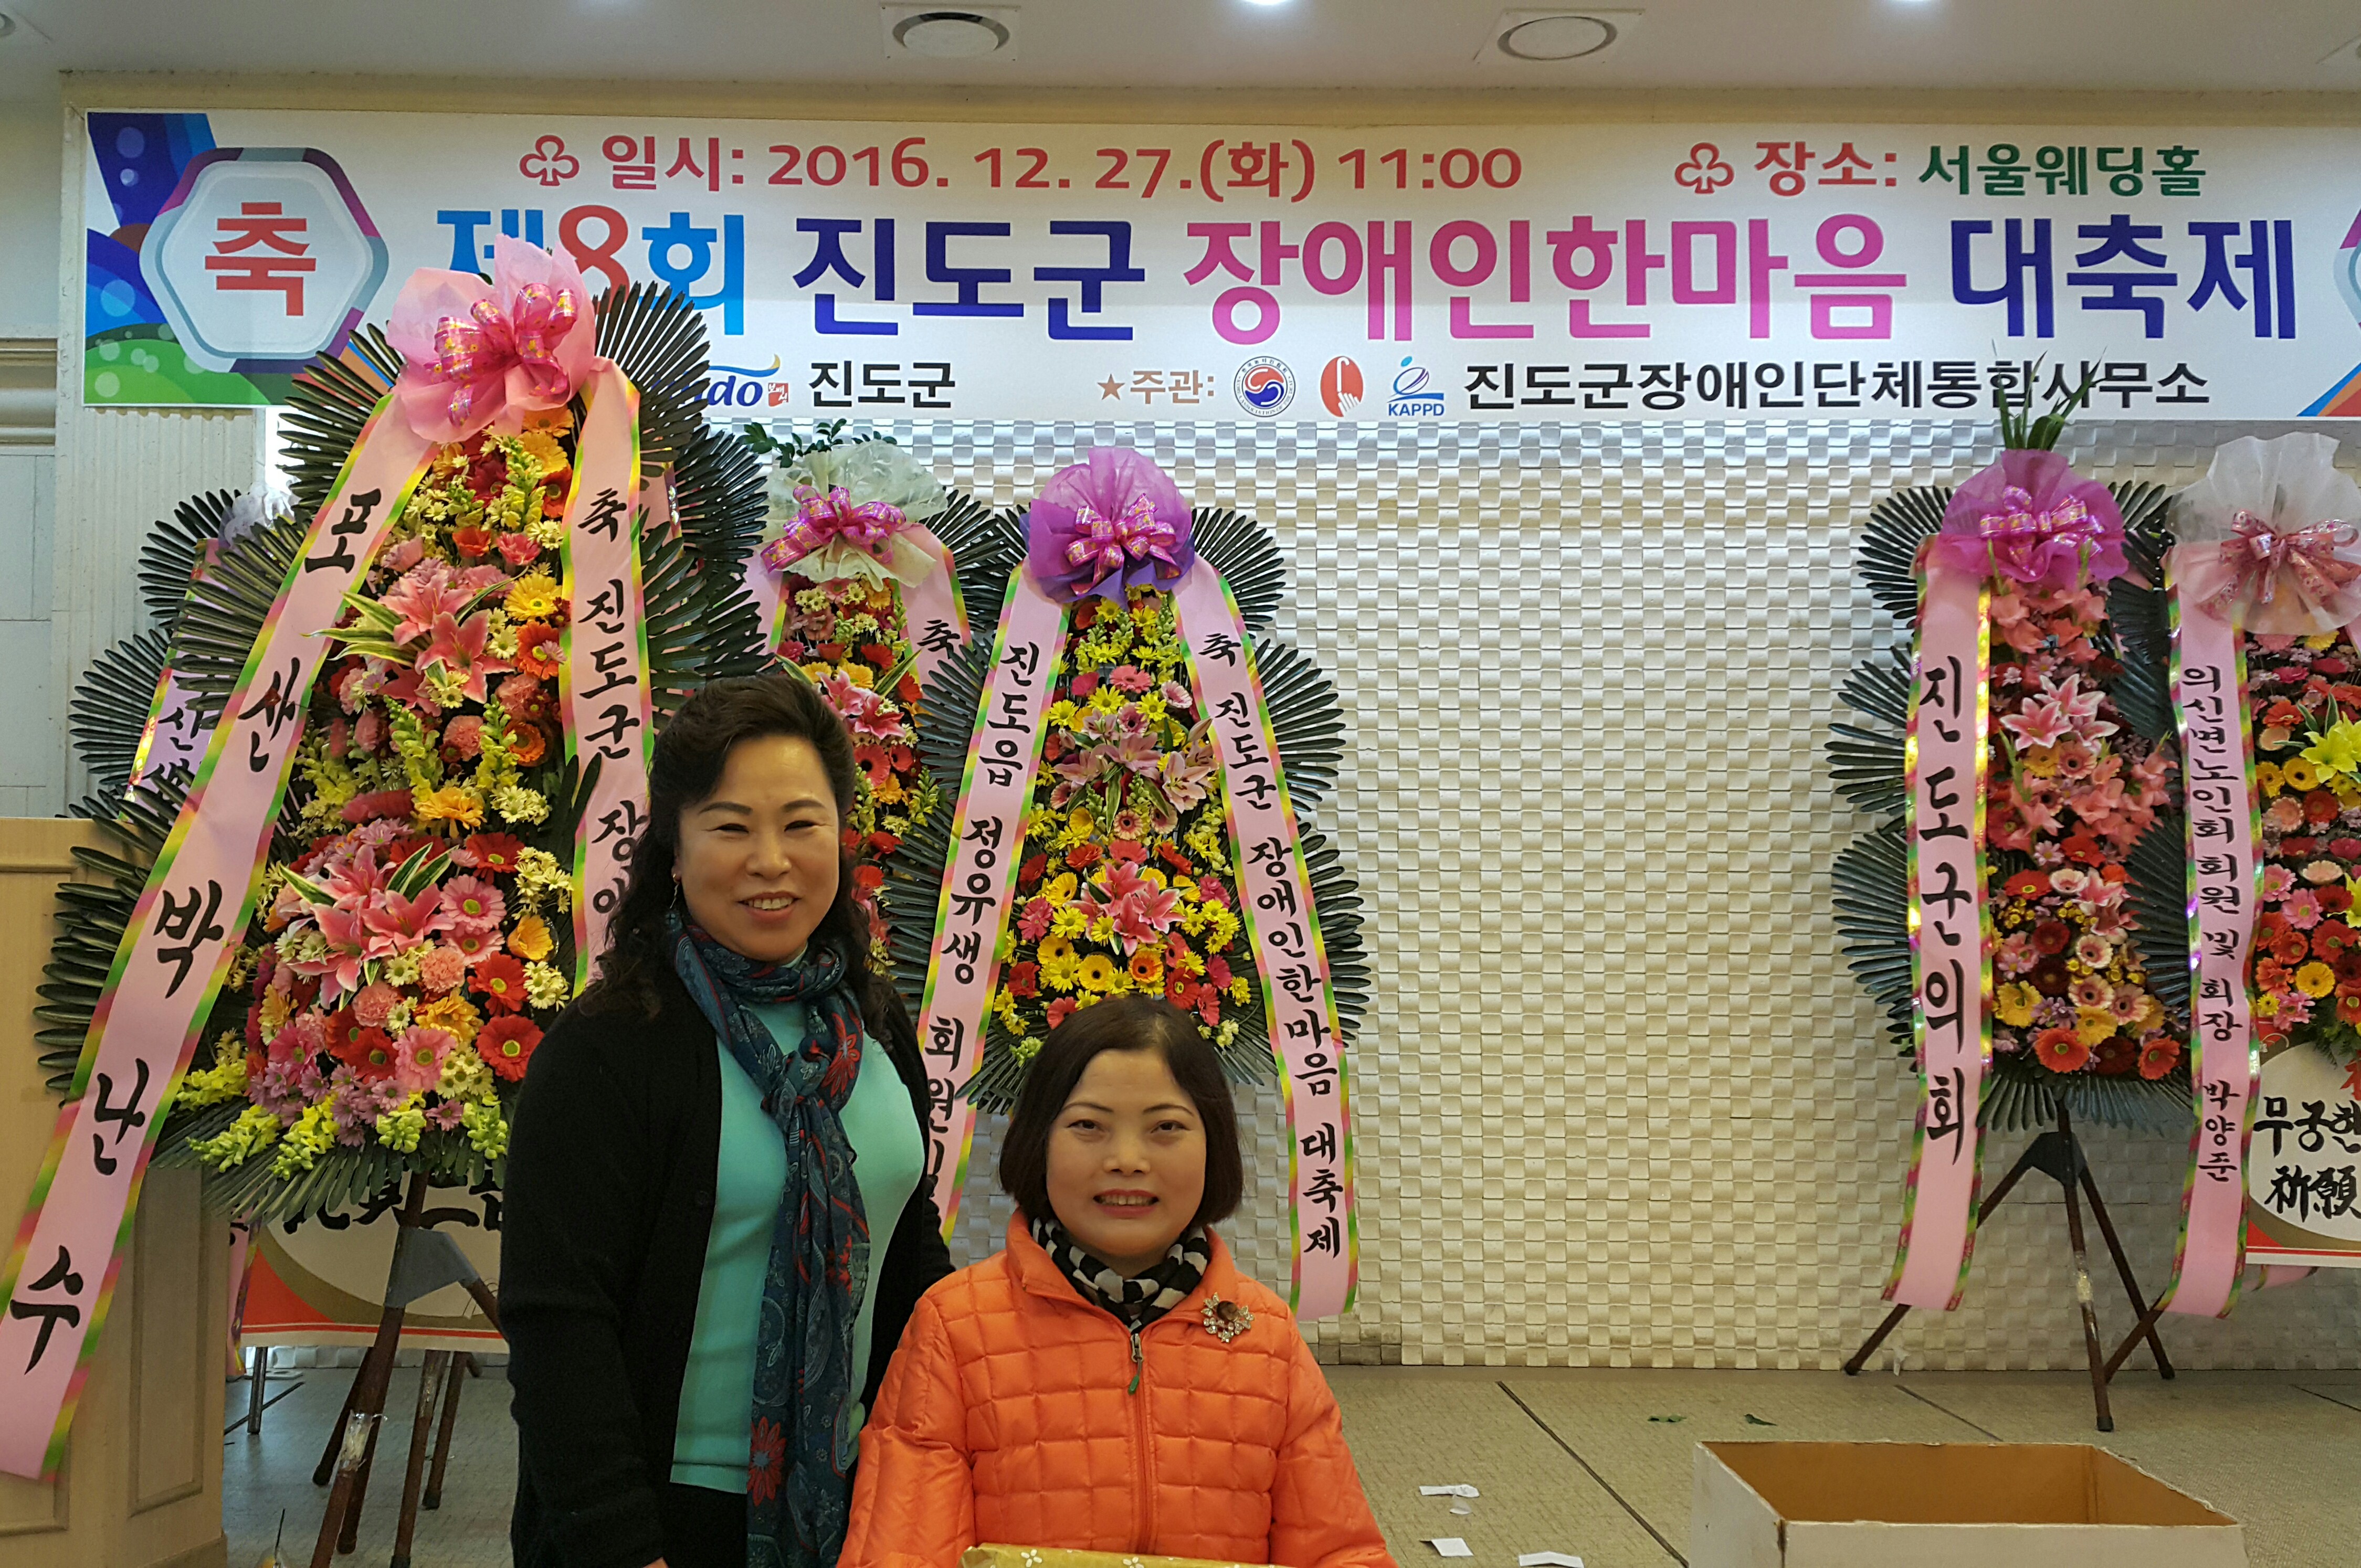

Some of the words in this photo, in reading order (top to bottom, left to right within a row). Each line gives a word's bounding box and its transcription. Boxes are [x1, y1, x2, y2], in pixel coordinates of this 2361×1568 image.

[603, 135, 744, 192] 일시:
[768, 137, 948, 187] 2016.
[974, 148, 1070, 188] 12.
[1095, 140, 1315, 203] 27.(화)
[1338, 148, 1522, 189] 11:00
[1755, 142, 1896, 196] 장소:
[1920, 143, 2206, 196] 서울웨딩홀
[205, 202, 316, 316] 축
[793, 218, 1145, 341] 진도군
[1184, 214, 1906, 345] 장애인한마음
[1951, 215, 2296, 340] 대축제
[809, 361, 955, 408] 진도군
[1130, 368, 1215, 405] 주관:
[1388, 402, 1445, 417] KAPPD
[1464, 361, 2210, 409] 진도군장애인단체통합사무소
[578, 488, 627, 542] 축
[578, 578, 640, 759] 진도군
[918, 619, 961, 659] 축
[1198, 633, 1242, 667] 축
[979, 641, 1040, 787] 진도읍
[1215, 692, 1277, 810] 진도군
[942, 816, 1003, 984] 정유생
[1919, 655, 1972, 1165] 진도군의회
[1247, 837, 1338, 1096] 장애인한마음
[2202, 928, 2239, 960] 및
[2200, 978, 2243, 1042] 회장
[2198, 1079, 2240, 1182] 박양준
[1300, 1123, 1344, 1258] 대축제
